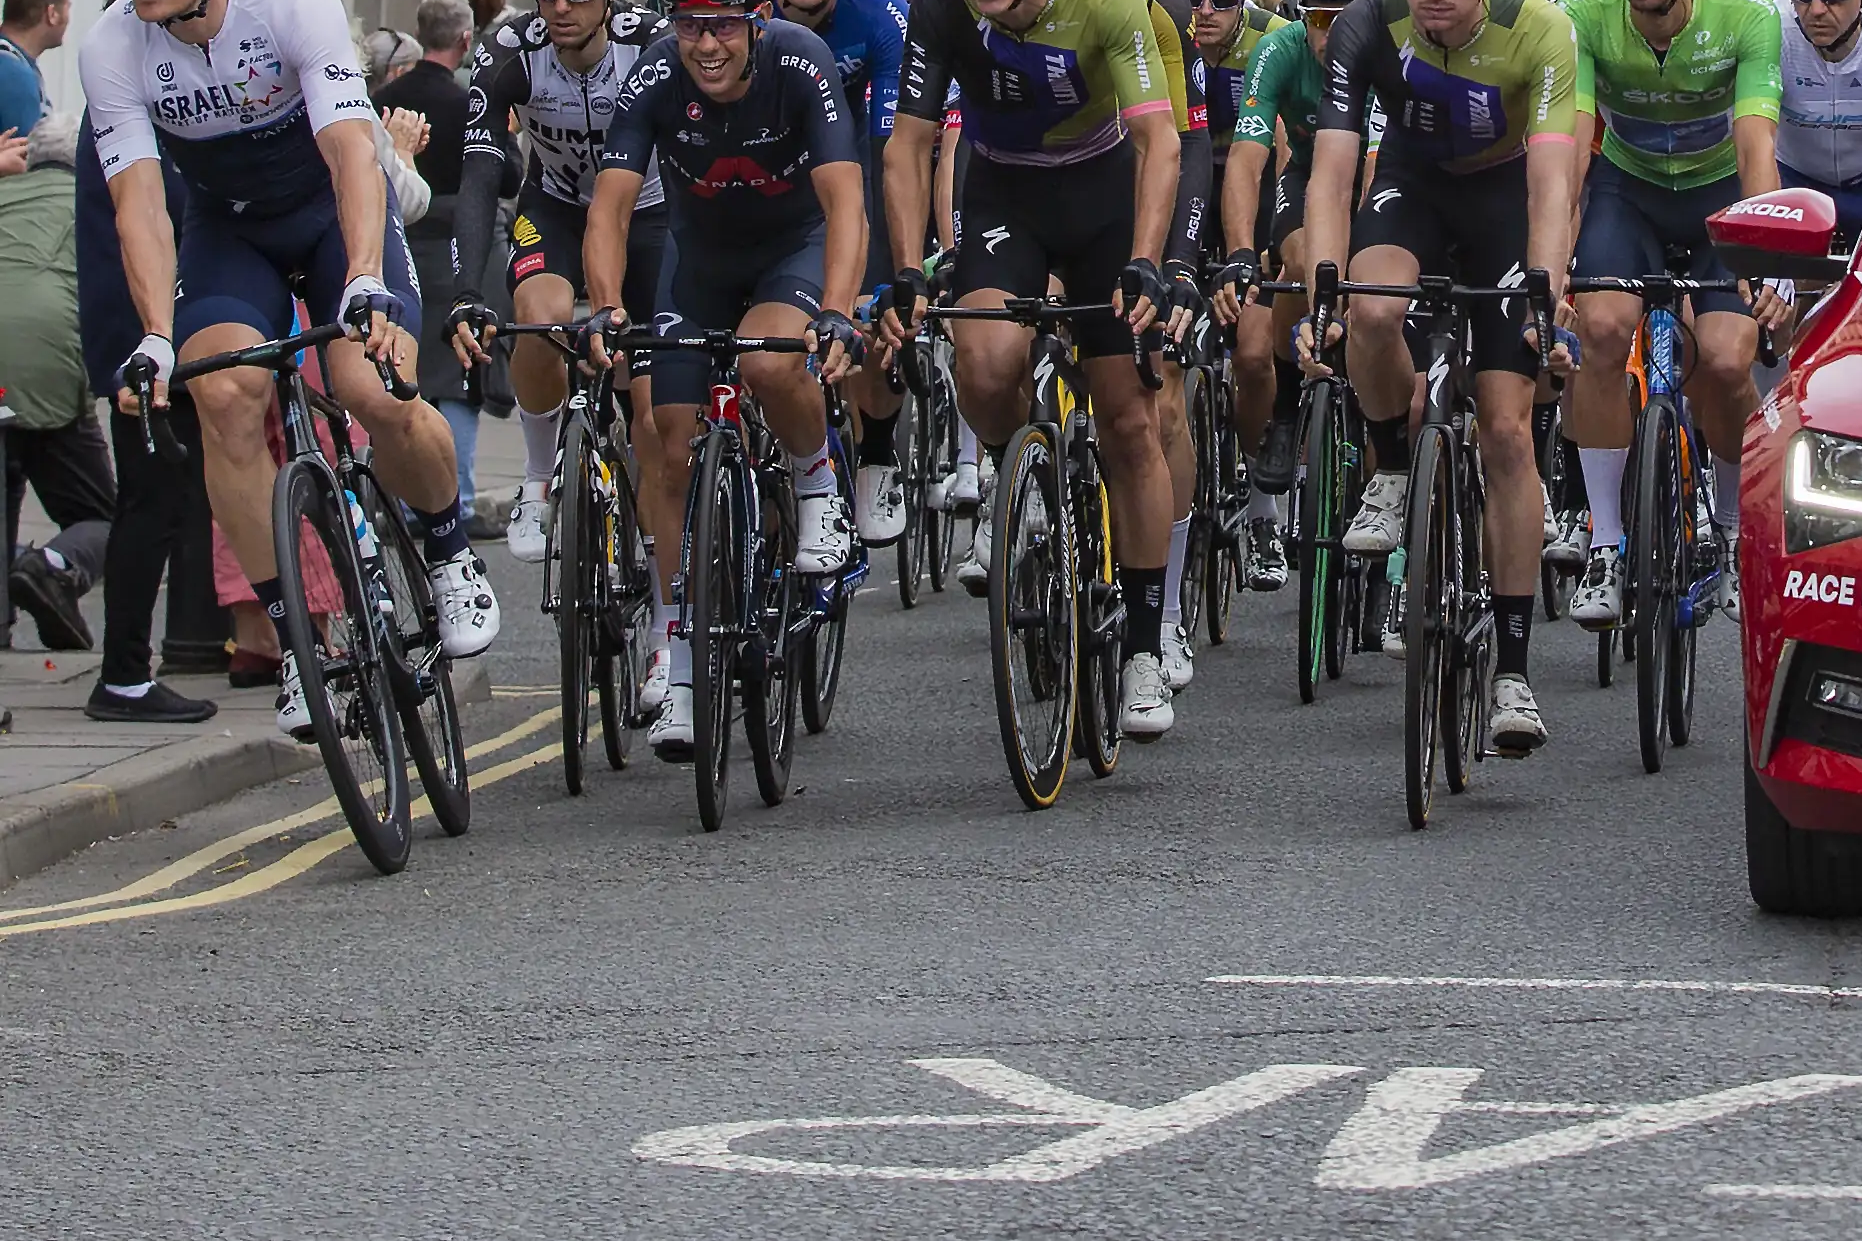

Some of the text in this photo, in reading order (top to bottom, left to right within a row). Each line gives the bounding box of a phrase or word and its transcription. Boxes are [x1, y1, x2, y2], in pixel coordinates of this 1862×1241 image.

[153, 83, 242, 120] ISRAEL
[617, 58, 672, 111] INEOS
[1783, 570, 1855, 607] RACE
